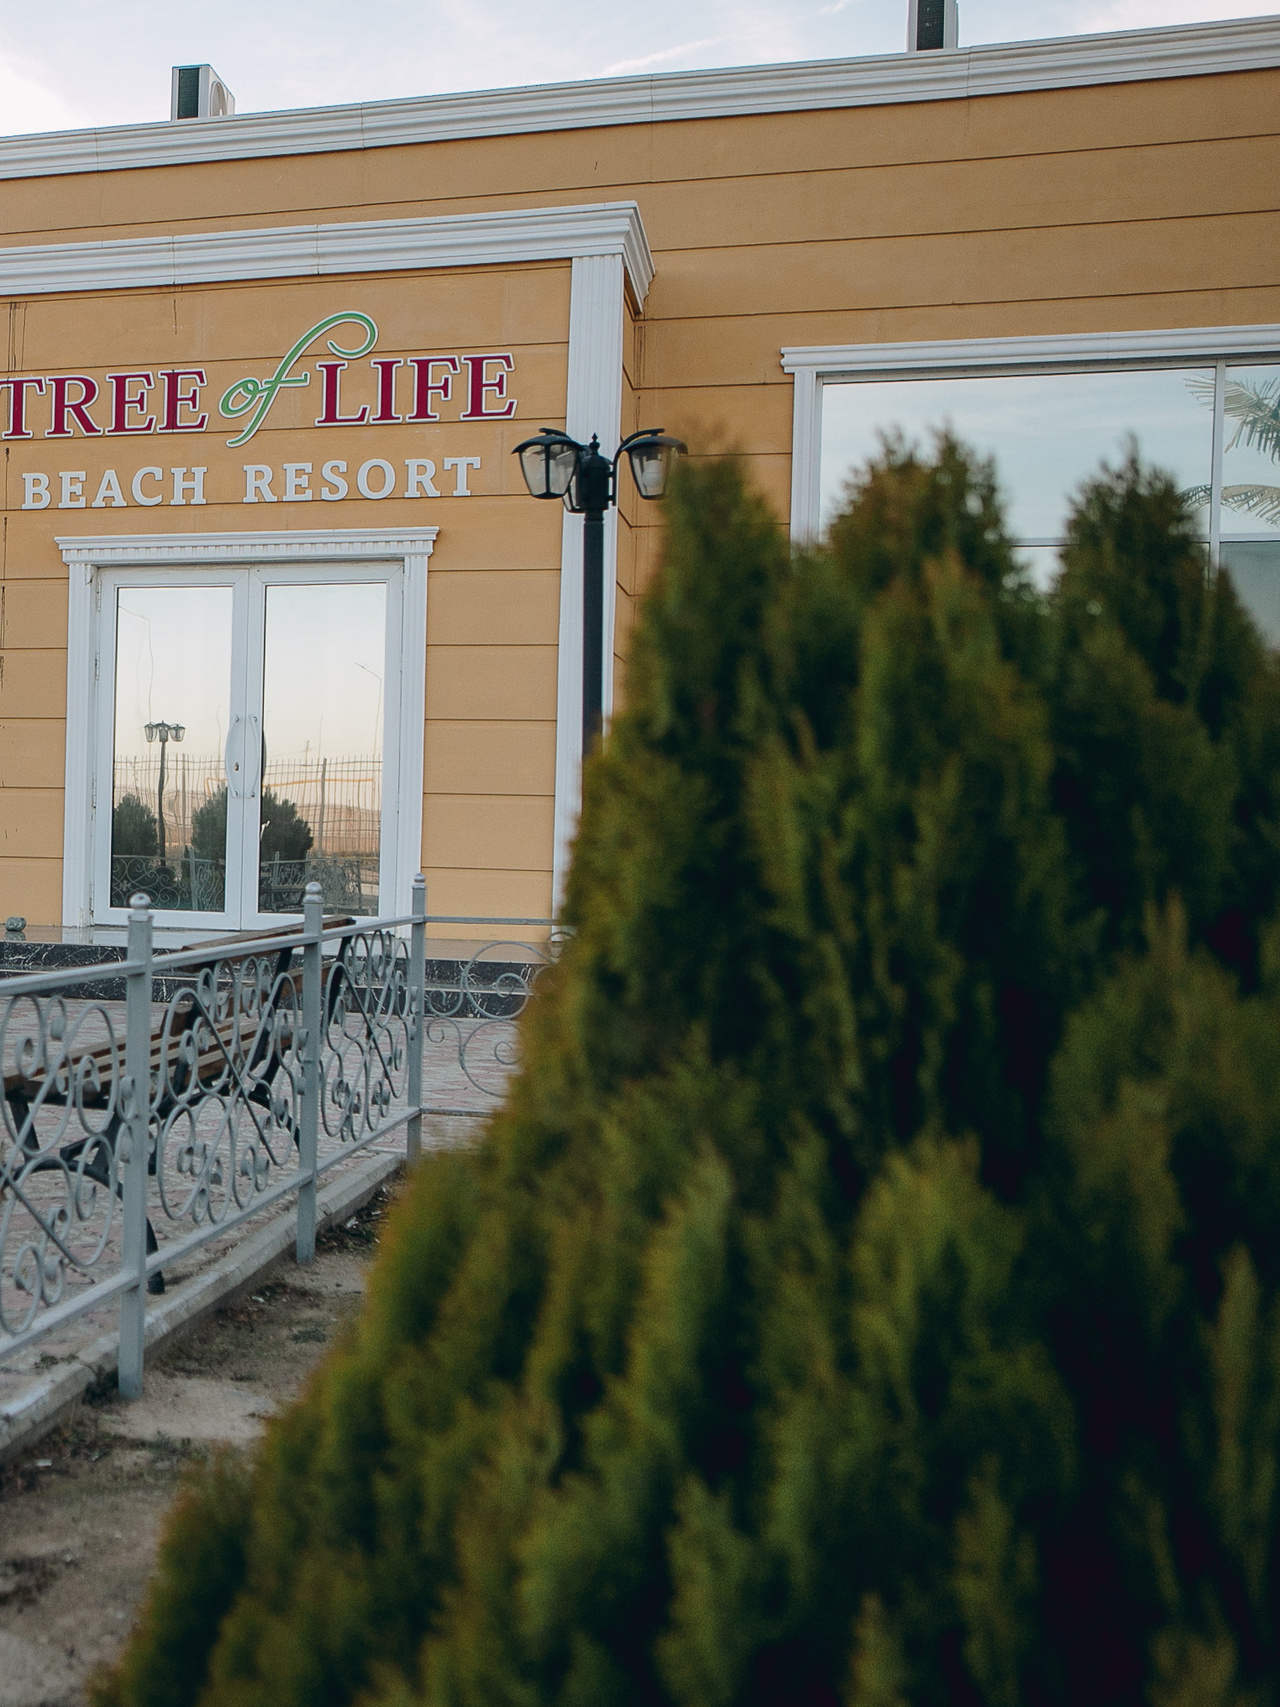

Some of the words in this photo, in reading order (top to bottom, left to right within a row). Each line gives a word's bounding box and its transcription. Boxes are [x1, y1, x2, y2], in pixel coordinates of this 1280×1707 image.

[219, 311, 378, 447] of
[315, 353, 518, 427] LIFE
[21, 466, 208, 510] BEACH
[243, 456, 481, 503] RESORT
